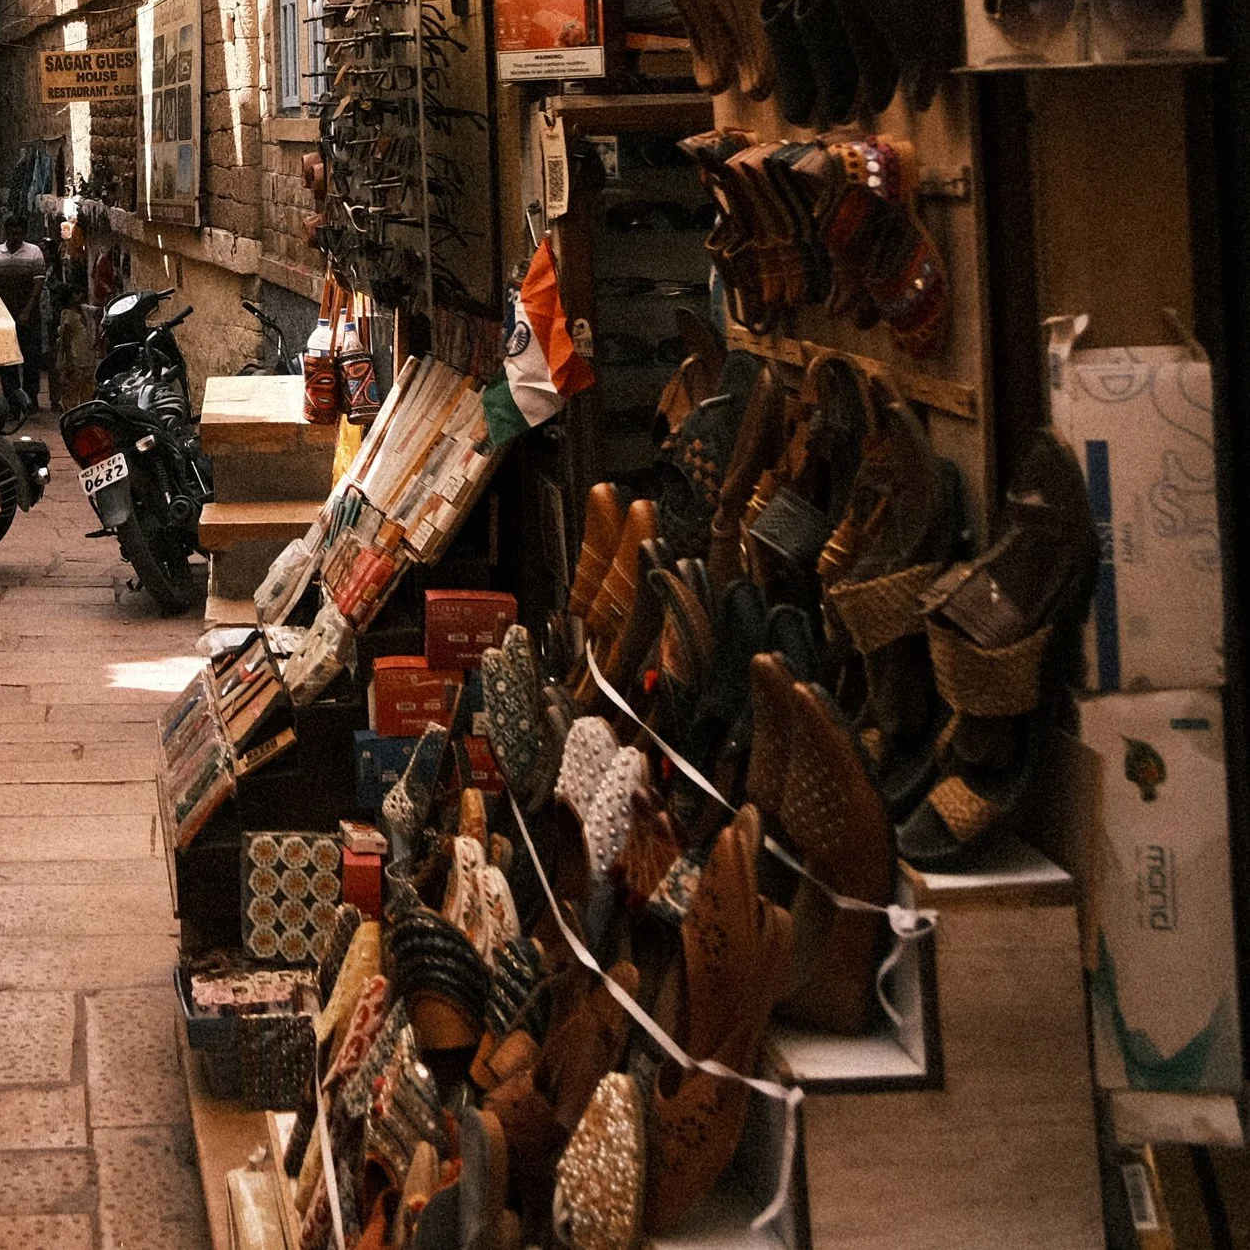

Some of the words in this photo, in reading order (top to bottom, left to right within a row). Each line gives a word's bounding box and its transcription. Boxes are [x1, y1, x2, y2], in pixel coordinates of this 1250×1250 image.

[45, 54, 92, 72] SAGAR
[96, 52, 137, 70] GUES
[76, 71, 118, 83] HOUSE
[85, 464, 124, 492] 0682
